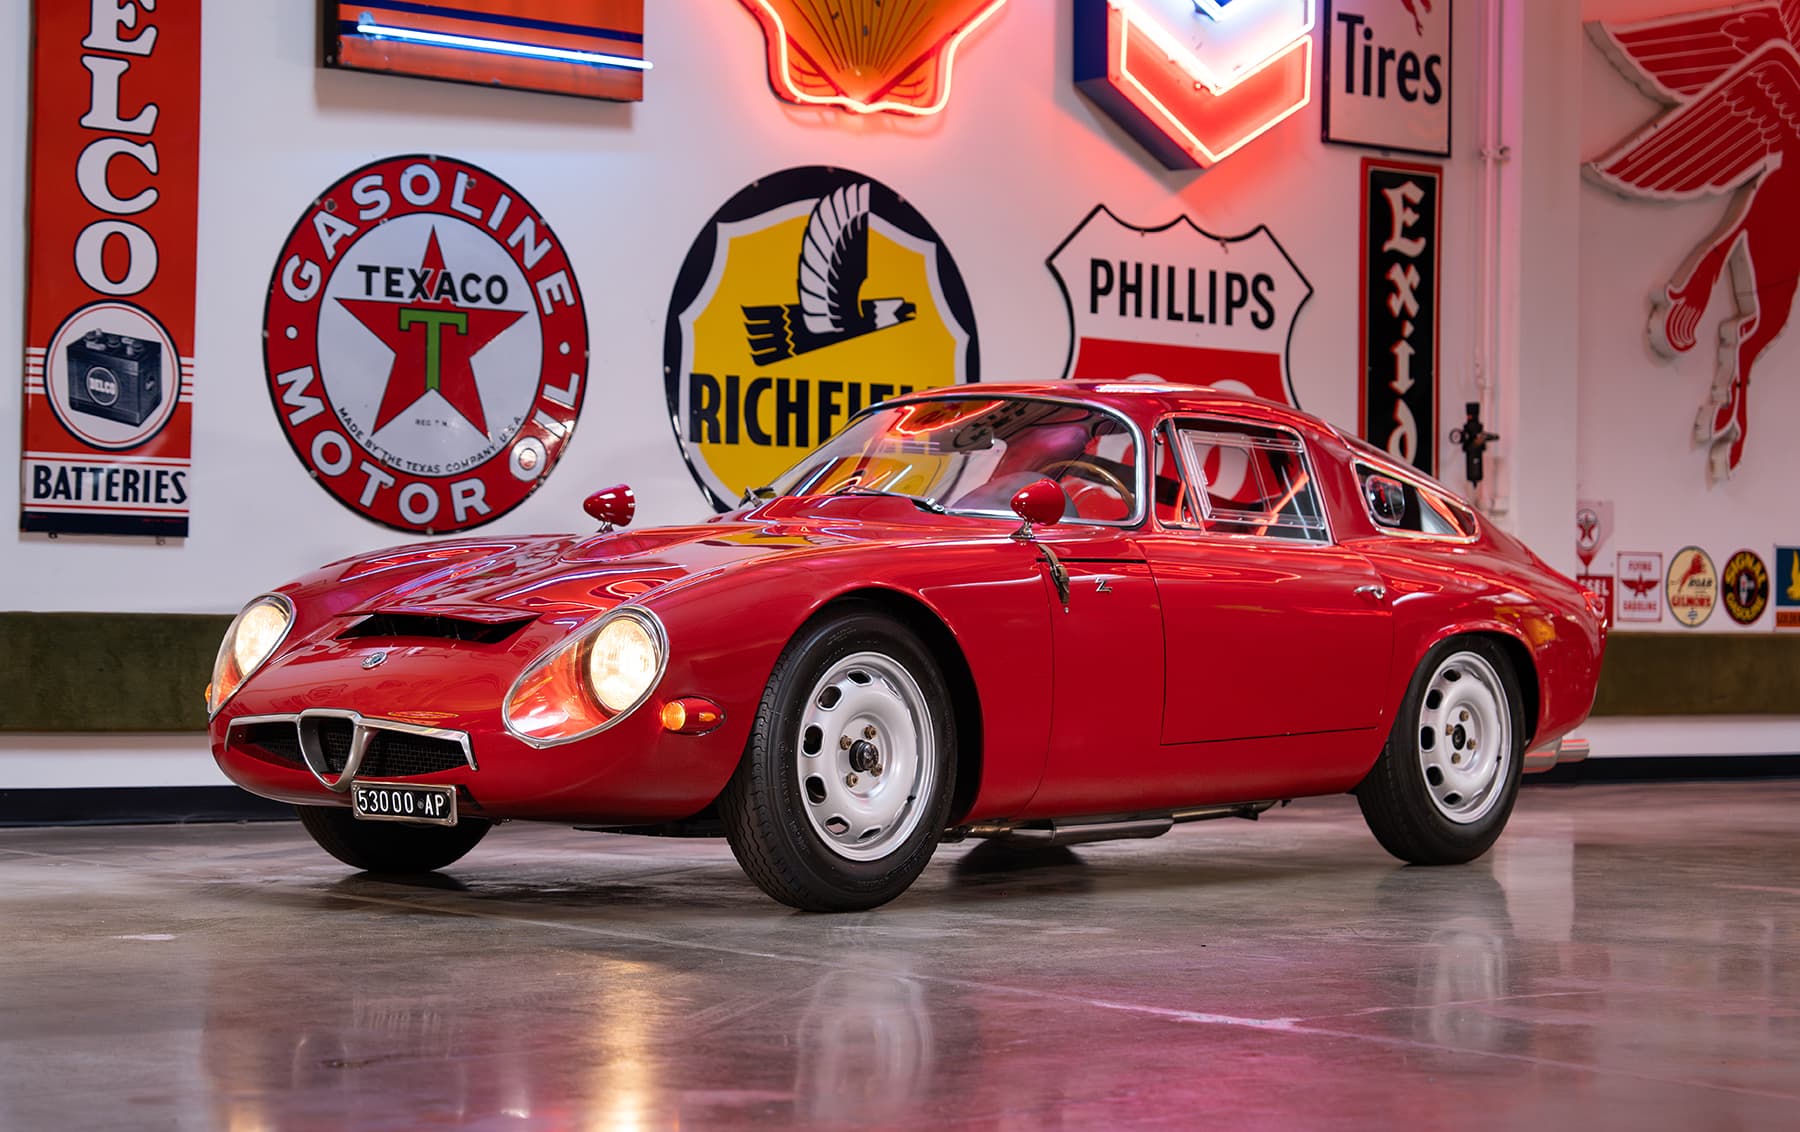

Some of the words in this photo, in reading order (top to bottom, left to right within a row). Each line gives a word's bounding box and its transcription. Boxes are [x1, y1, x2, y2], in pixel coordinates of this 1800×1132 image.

[1337, 11, 1442, 106] Tires
[281, 163, 576, 315] GASOLINE
[357, 265, 509, 304] TEXACO
[1090, 258, 1276, 330] PHILLIPS
[399, 307, 468, 391] T
[89, 377, 116, 395] DELCO
[276, 365, 493, 525] MOTOR
[508, 373, 580, 482] OIL
[338, 407, 365, 439] MADE
[365, 438, 382, 453] BY
[381, 450, 402, 467] THE
[406, 461, 441, 474] TEXAS
[446, 444, 497, 473] COMPANY
[32, 465, 188, 504] BATTERIES
[358, 790, 414, 814] 53000
[425, 794, 445, 816] AP
